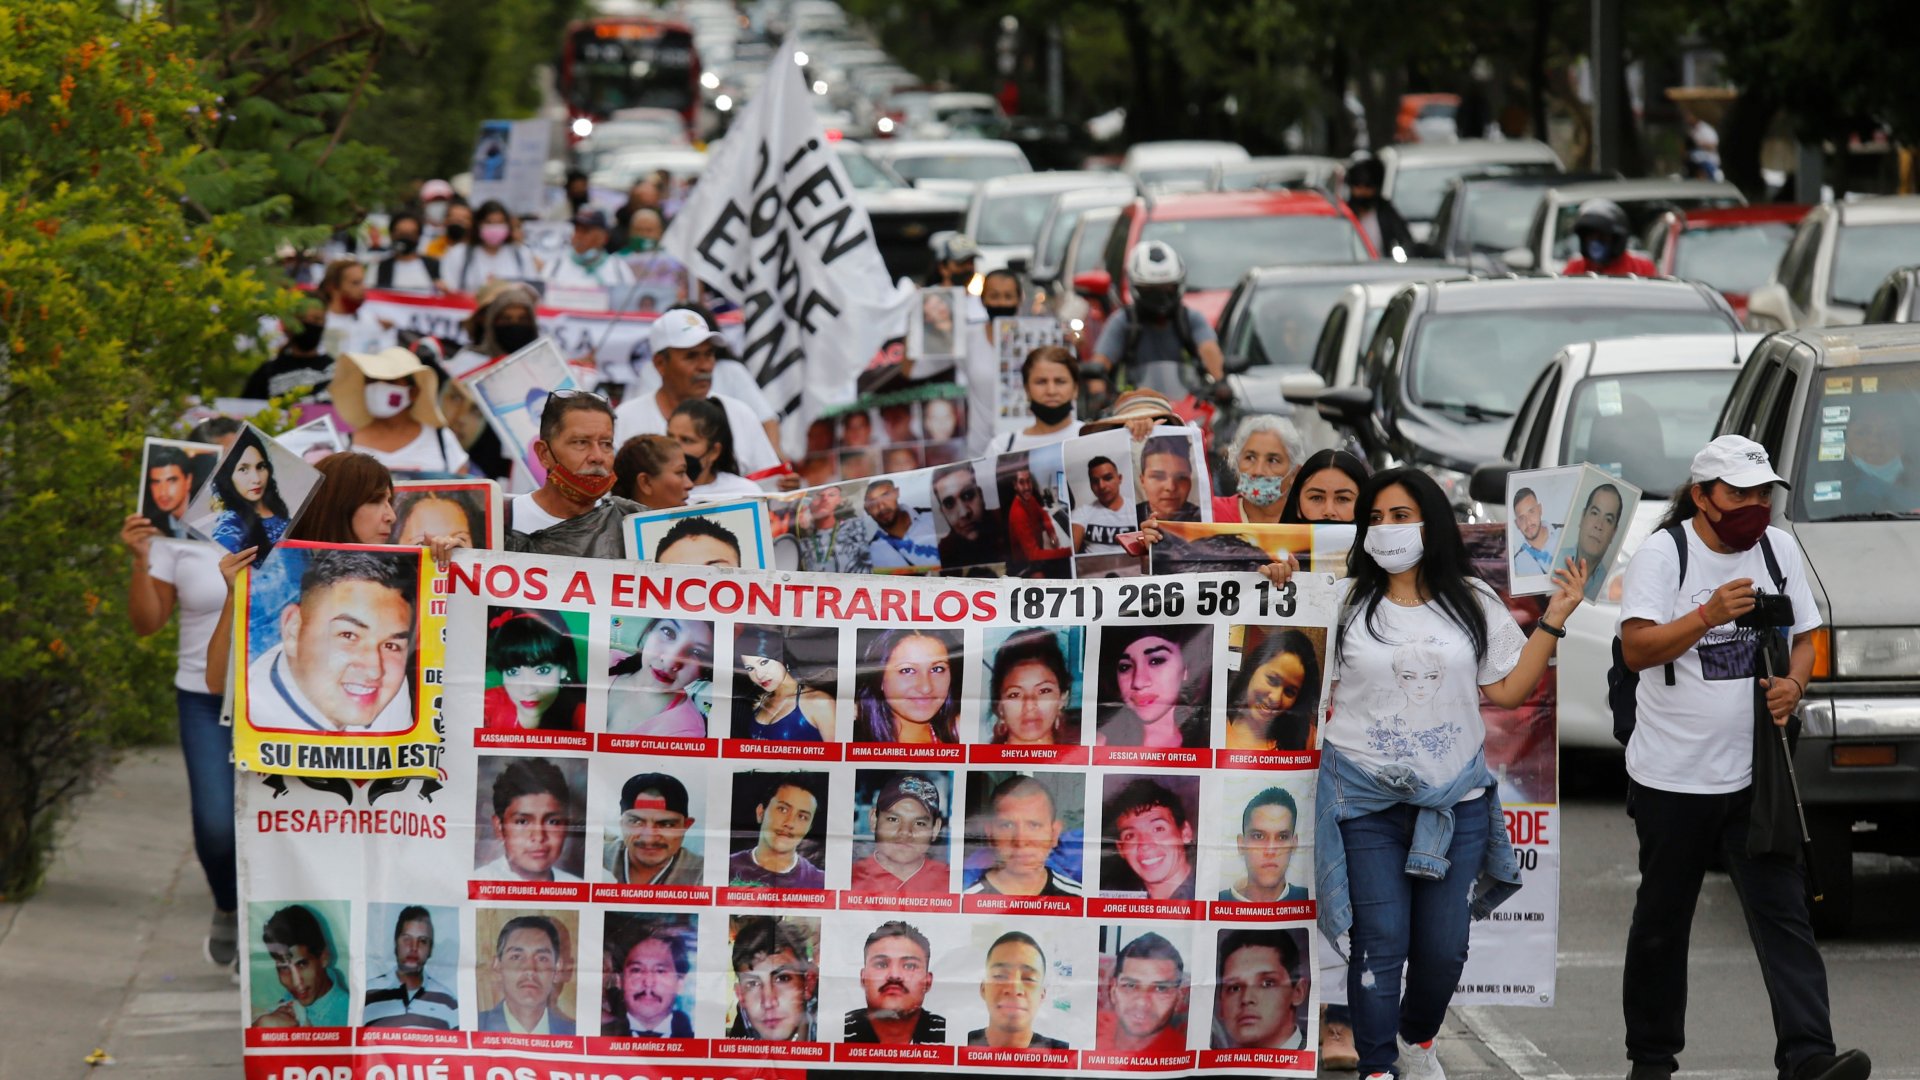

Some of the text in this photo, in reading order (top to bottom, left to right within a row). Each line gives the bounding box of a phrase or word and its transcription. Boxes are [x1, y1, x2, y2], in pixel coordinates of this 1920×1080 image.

[447, 562, 1297, 623] NOS A ENCONTRARLOS (871) 266 58 13
[481, 733, 587, 746] KASSANDRA BALLIN LIMONES
[611, 738, 705, 752] GATSBY CITLALI CALVILLO
[740, 743, 825, 756] SOFIA ELIZABETH ORTIZ
[852, 747, 960, 758] IRMA CLARIBEL LAMAS LOPEZ
[1001, 749, 1057, 759] SHEYLA WENDY
[260, 743, 292, 767] SU
[298, 745, 392, 770] FAMILIA
[1108, 751, 1197, 762] JESSICA VIANEY ORTEGA
[1230, 754, 1257, 764] REBECA
[1259, 755, 1293, 765] CORTINAS
[257, 808, 447, 839] DESAPARECIDAS
[479, 885, 578, 896] VICTOR ERUBIEL ANGUIANO
[595, 888, 709, 900] ANGEL RICARDO HIDALGO LUNA
[727, 891, 825, 903] MIGUEL ANGEL SAMANIEGO
[847, 895, 952, 907] NOE ANTONIO MENDEZ ROMO
[977, 899, 1071, 911] GABRIEL ANTONIO FAVELA
[1103, 903, 1191, 915] JORGE ULISES GRIJALVA
[1214, 906, 1234, 916] SAUL
[1236, 906, 1275, 916] EMMANUEL
[1276, 904, 1304, 915] CORTINAS
[1493, 912, 1512, 922] RELOJ
[1514, 912, 1523, 921] EN
[1524, 912, 1545, 922] MEDIO
[1467, 984, 1475, 993] EN
[1503, 984, 1511, 993] EN
[261, 1032, 289, 1042] MIGUEL
[291, 1032, 311, 1042] ORTIZ
[362, 1031, 381, 1041] JOSE
[482, 1035, 574, 1049] JOSE VICENTE CRUZ LOPEZ
[609, 1041, 684, 1052] JULIO RAMÍREZ RDZ.
[719, 1044, 823, 1056] LUIS ENRIQUE RMZ. ROMERO
[848, 1047, 940, 1059] JOSE CARLOS MEJÍA GLZ.
[968, 1051, 1069, 1063] EDGAR IVÁN OVIEDO DAVILA
[1215, 1053, 1299, 1064] JOSE RAUL CRUZ LOPEZ
[1088, 1055, 1105, 1065] IVAN
[1107, 1055, 1129, 1065] ISSAC
[1130, 1056, 1158, 1066] ALCALA
